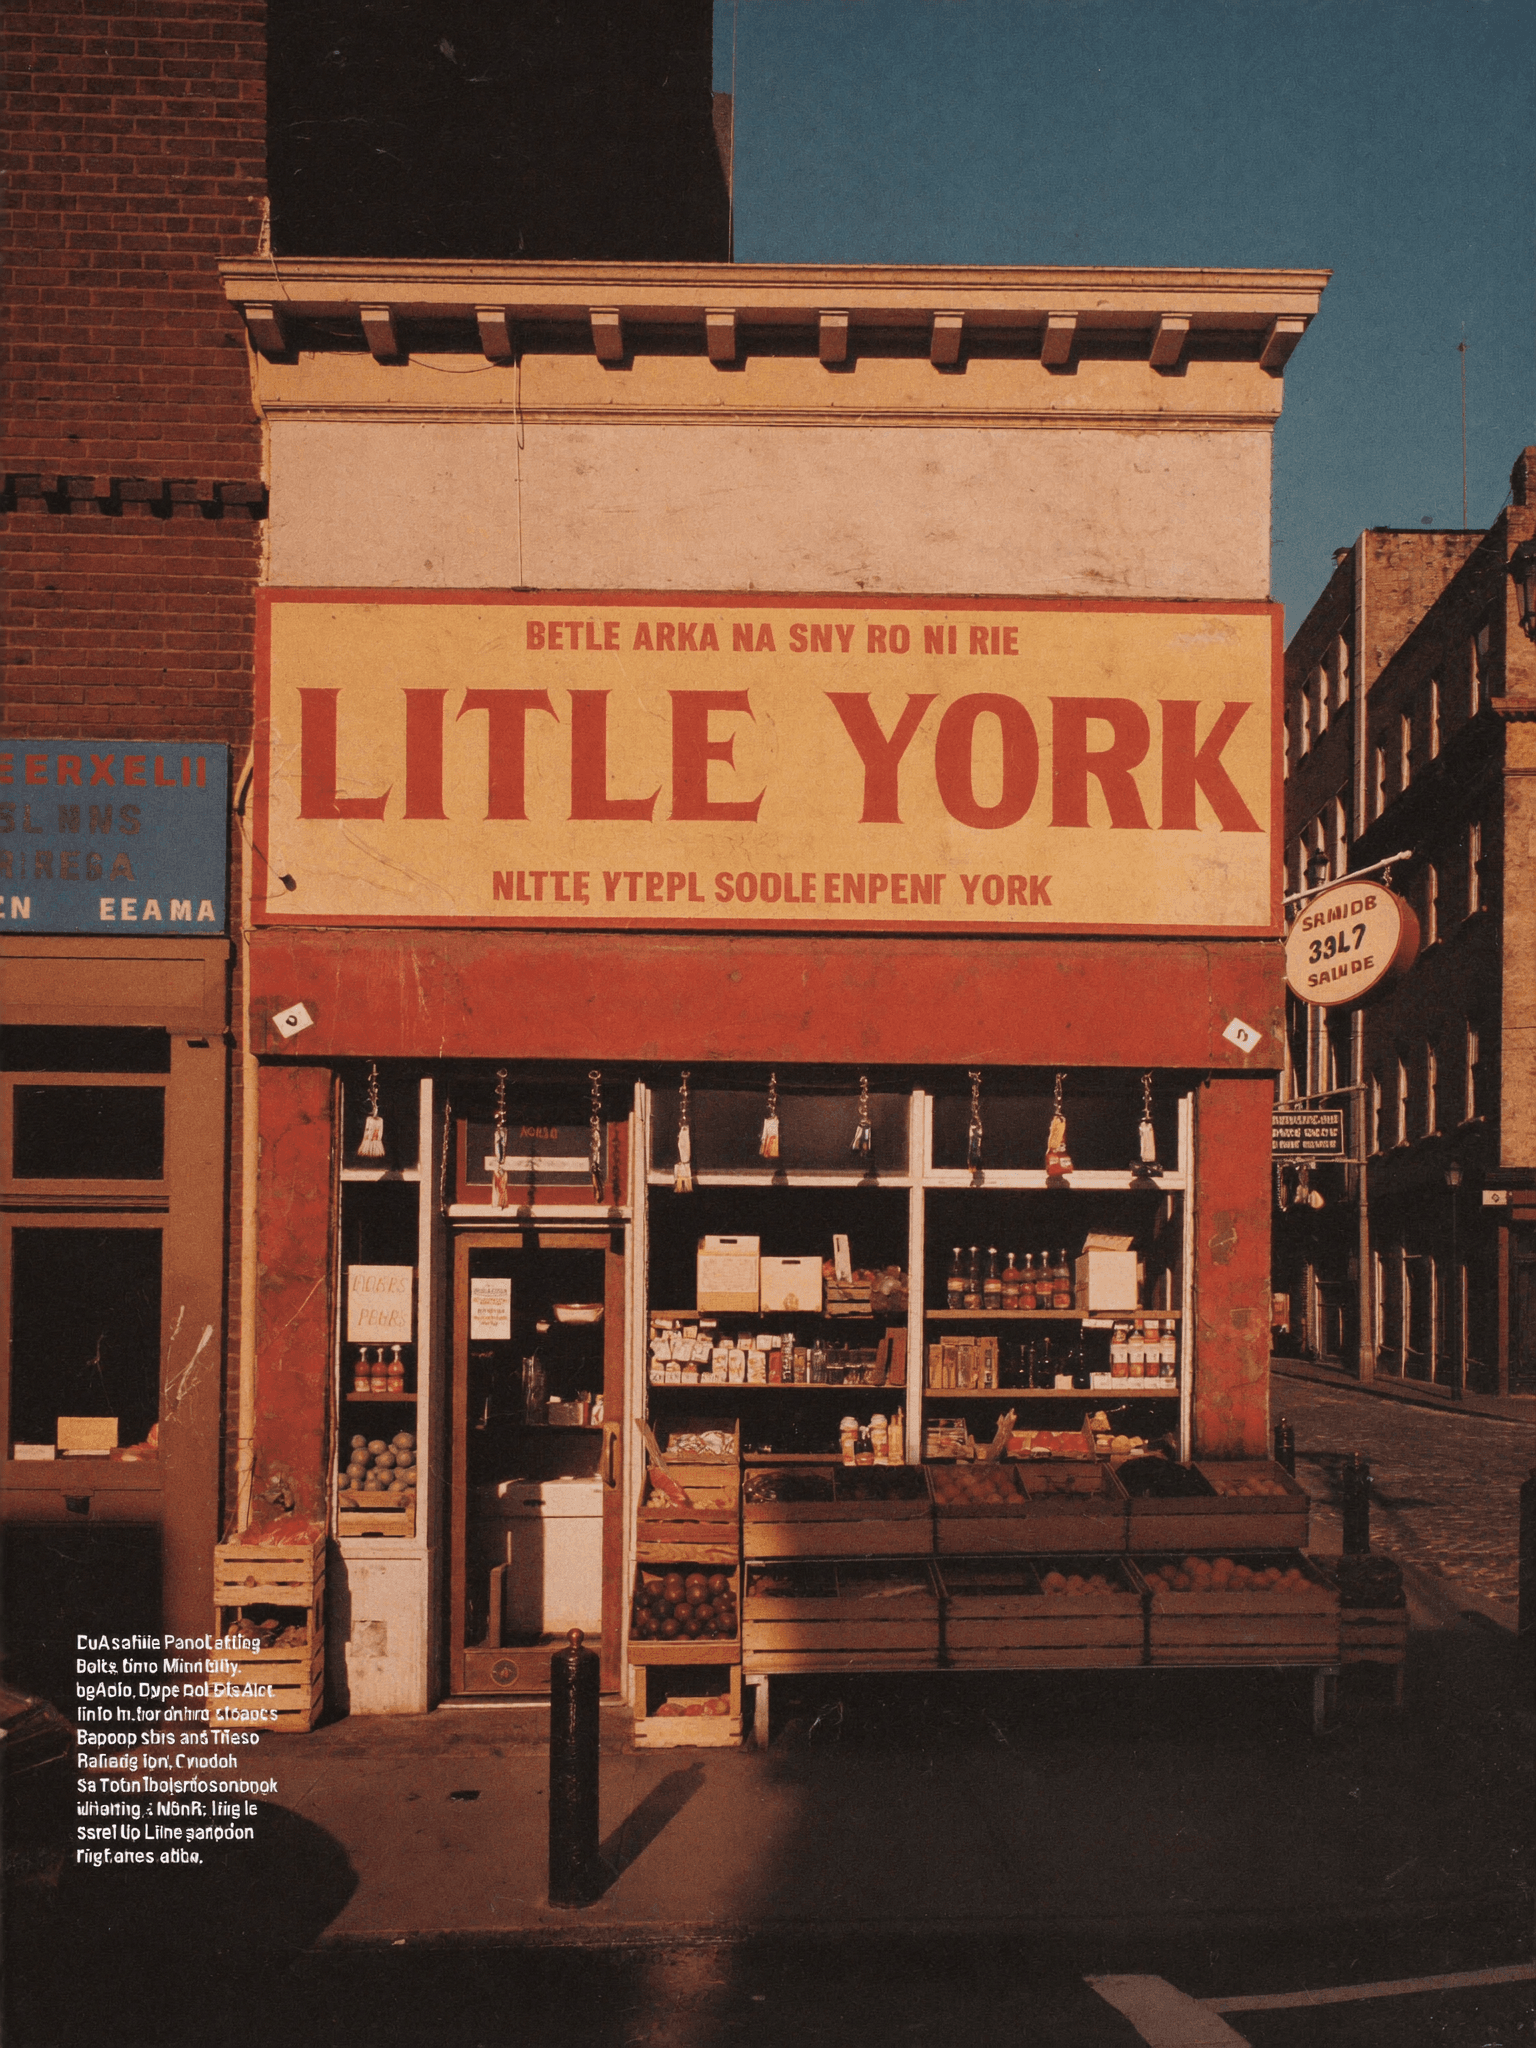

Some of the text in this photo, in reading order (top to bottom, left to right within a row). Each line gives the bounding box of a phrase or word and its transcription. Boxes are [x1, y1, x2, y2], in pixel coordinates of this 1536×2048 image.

[526, 620, 1020, 656] BETLE ARKA NA SNY RO NI RIE
[297, 686, 1266, 833] LITLE YORK
[959, 873, 1053, 906] YORK
